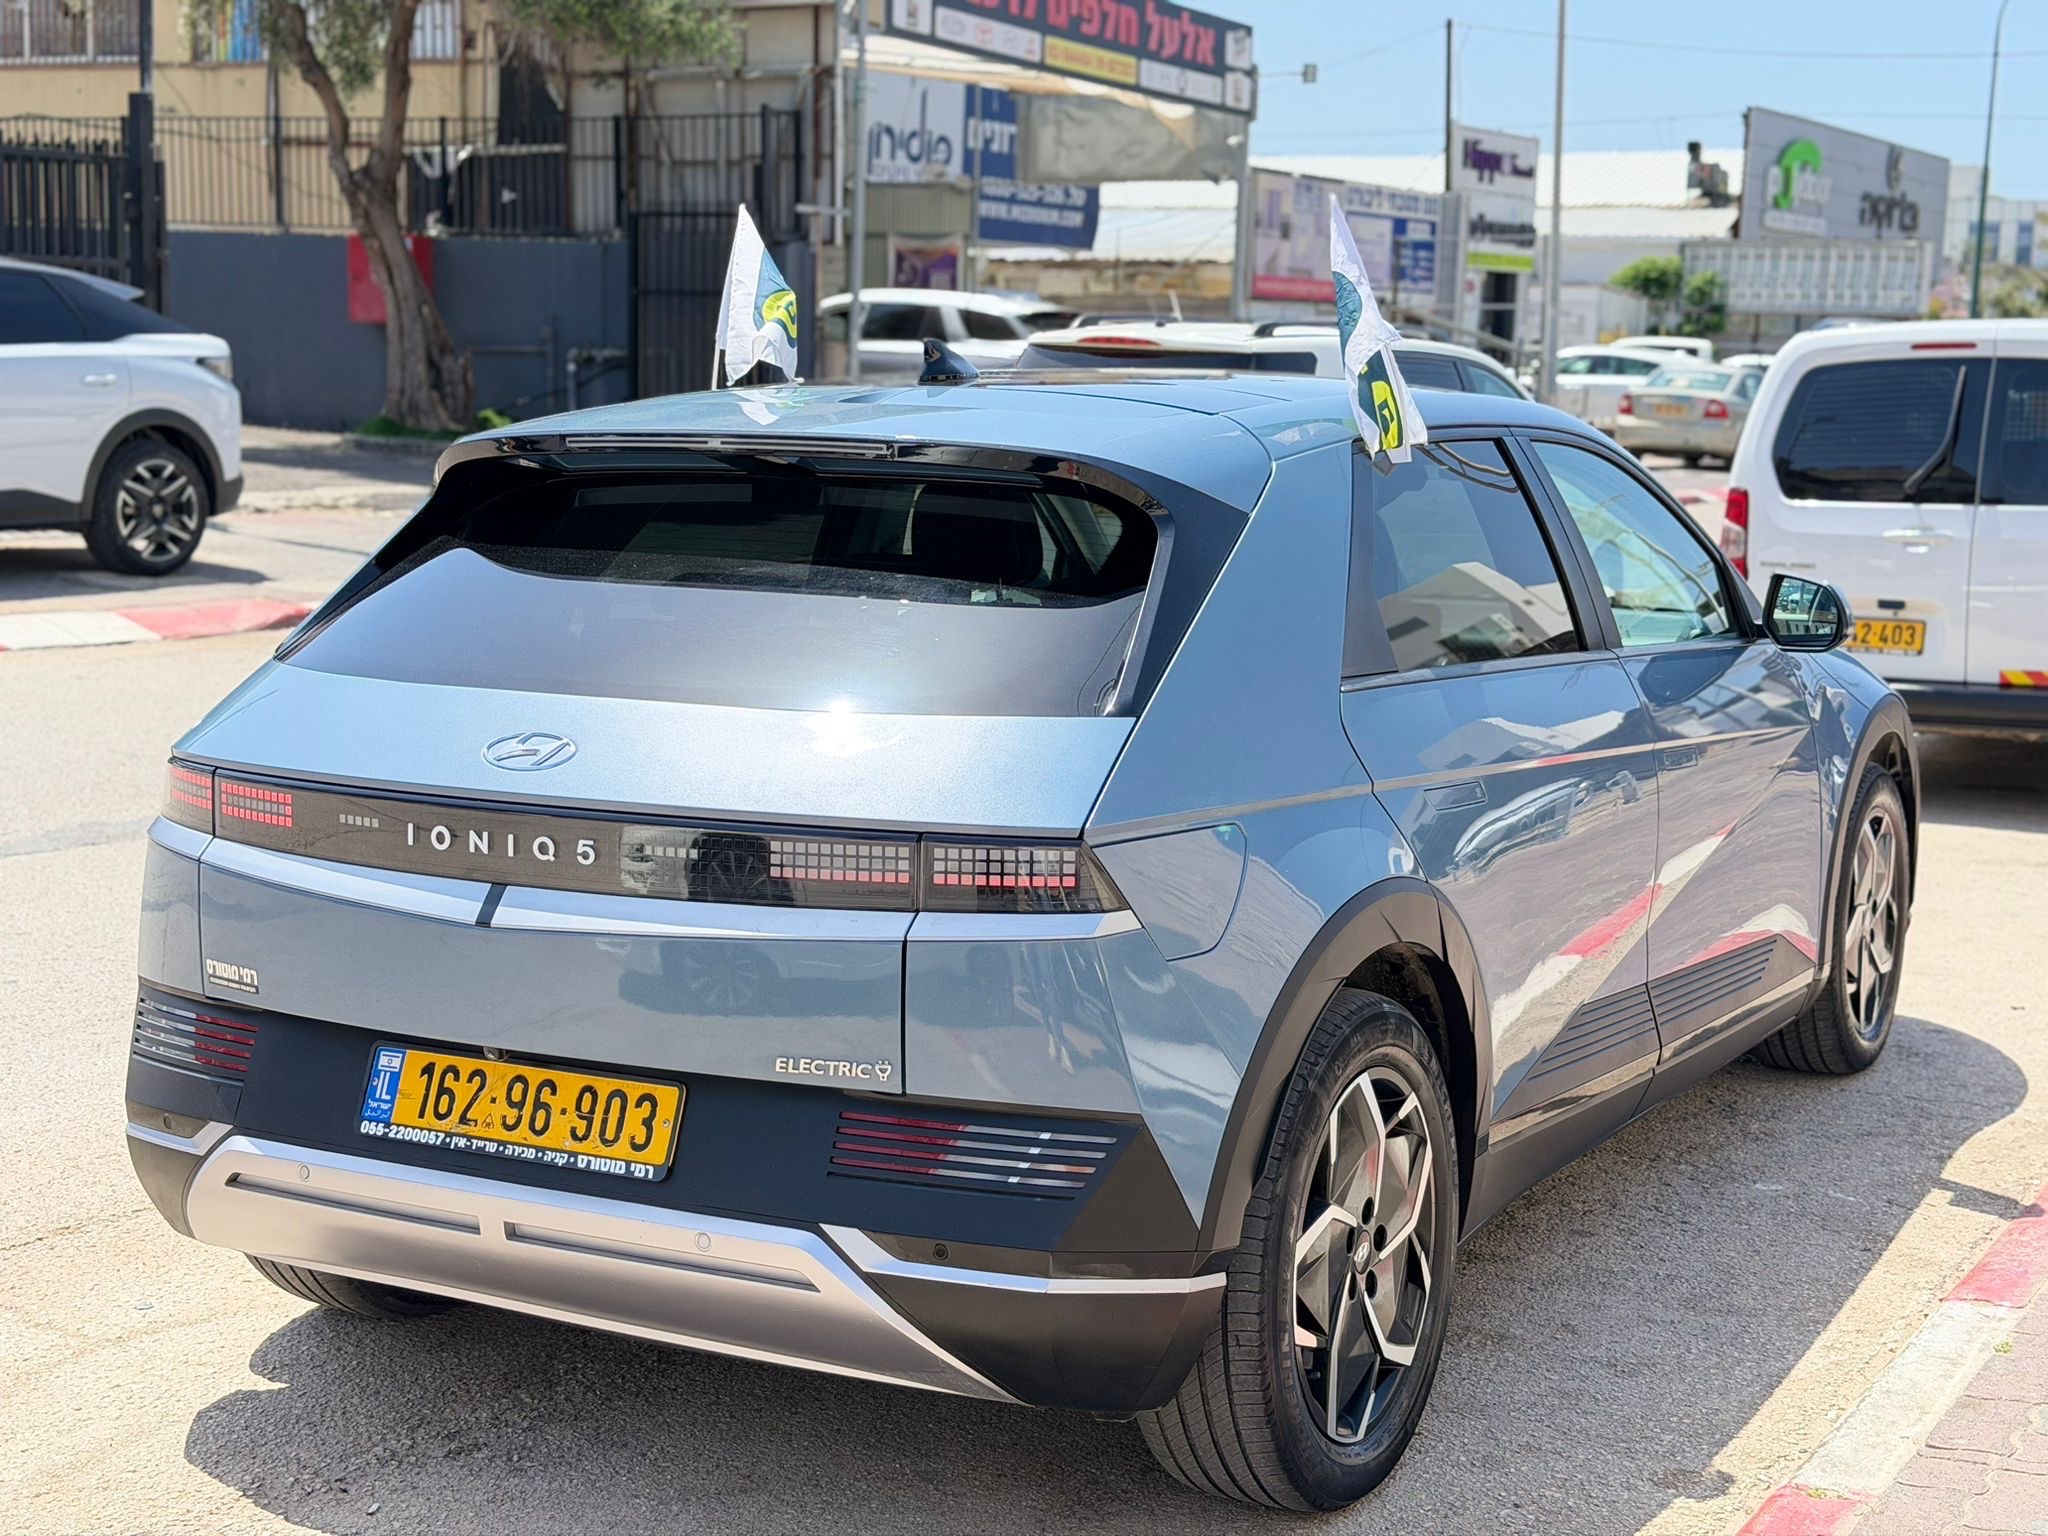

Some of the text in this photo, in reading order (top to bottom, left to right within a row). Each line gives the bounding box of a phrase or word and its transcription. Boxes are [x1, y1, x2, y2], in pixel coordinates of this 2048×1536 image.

[1145, 0, 1216, 66] אלעל
[407, 822, 596, 865] IONIQ 5
[206, 958, 239, 981] מוטורס
[239, 965, 258, 986] רמי
[775, 1057, 872, 1079] ELECTRIC
[375, 1071, 392, 1100] IL
[368, 1099, 392, 1110] ישראל
[360, 1121, 655, 1179] רמי מוטורס קניה מכירה טרייד-אין 055-2200057
